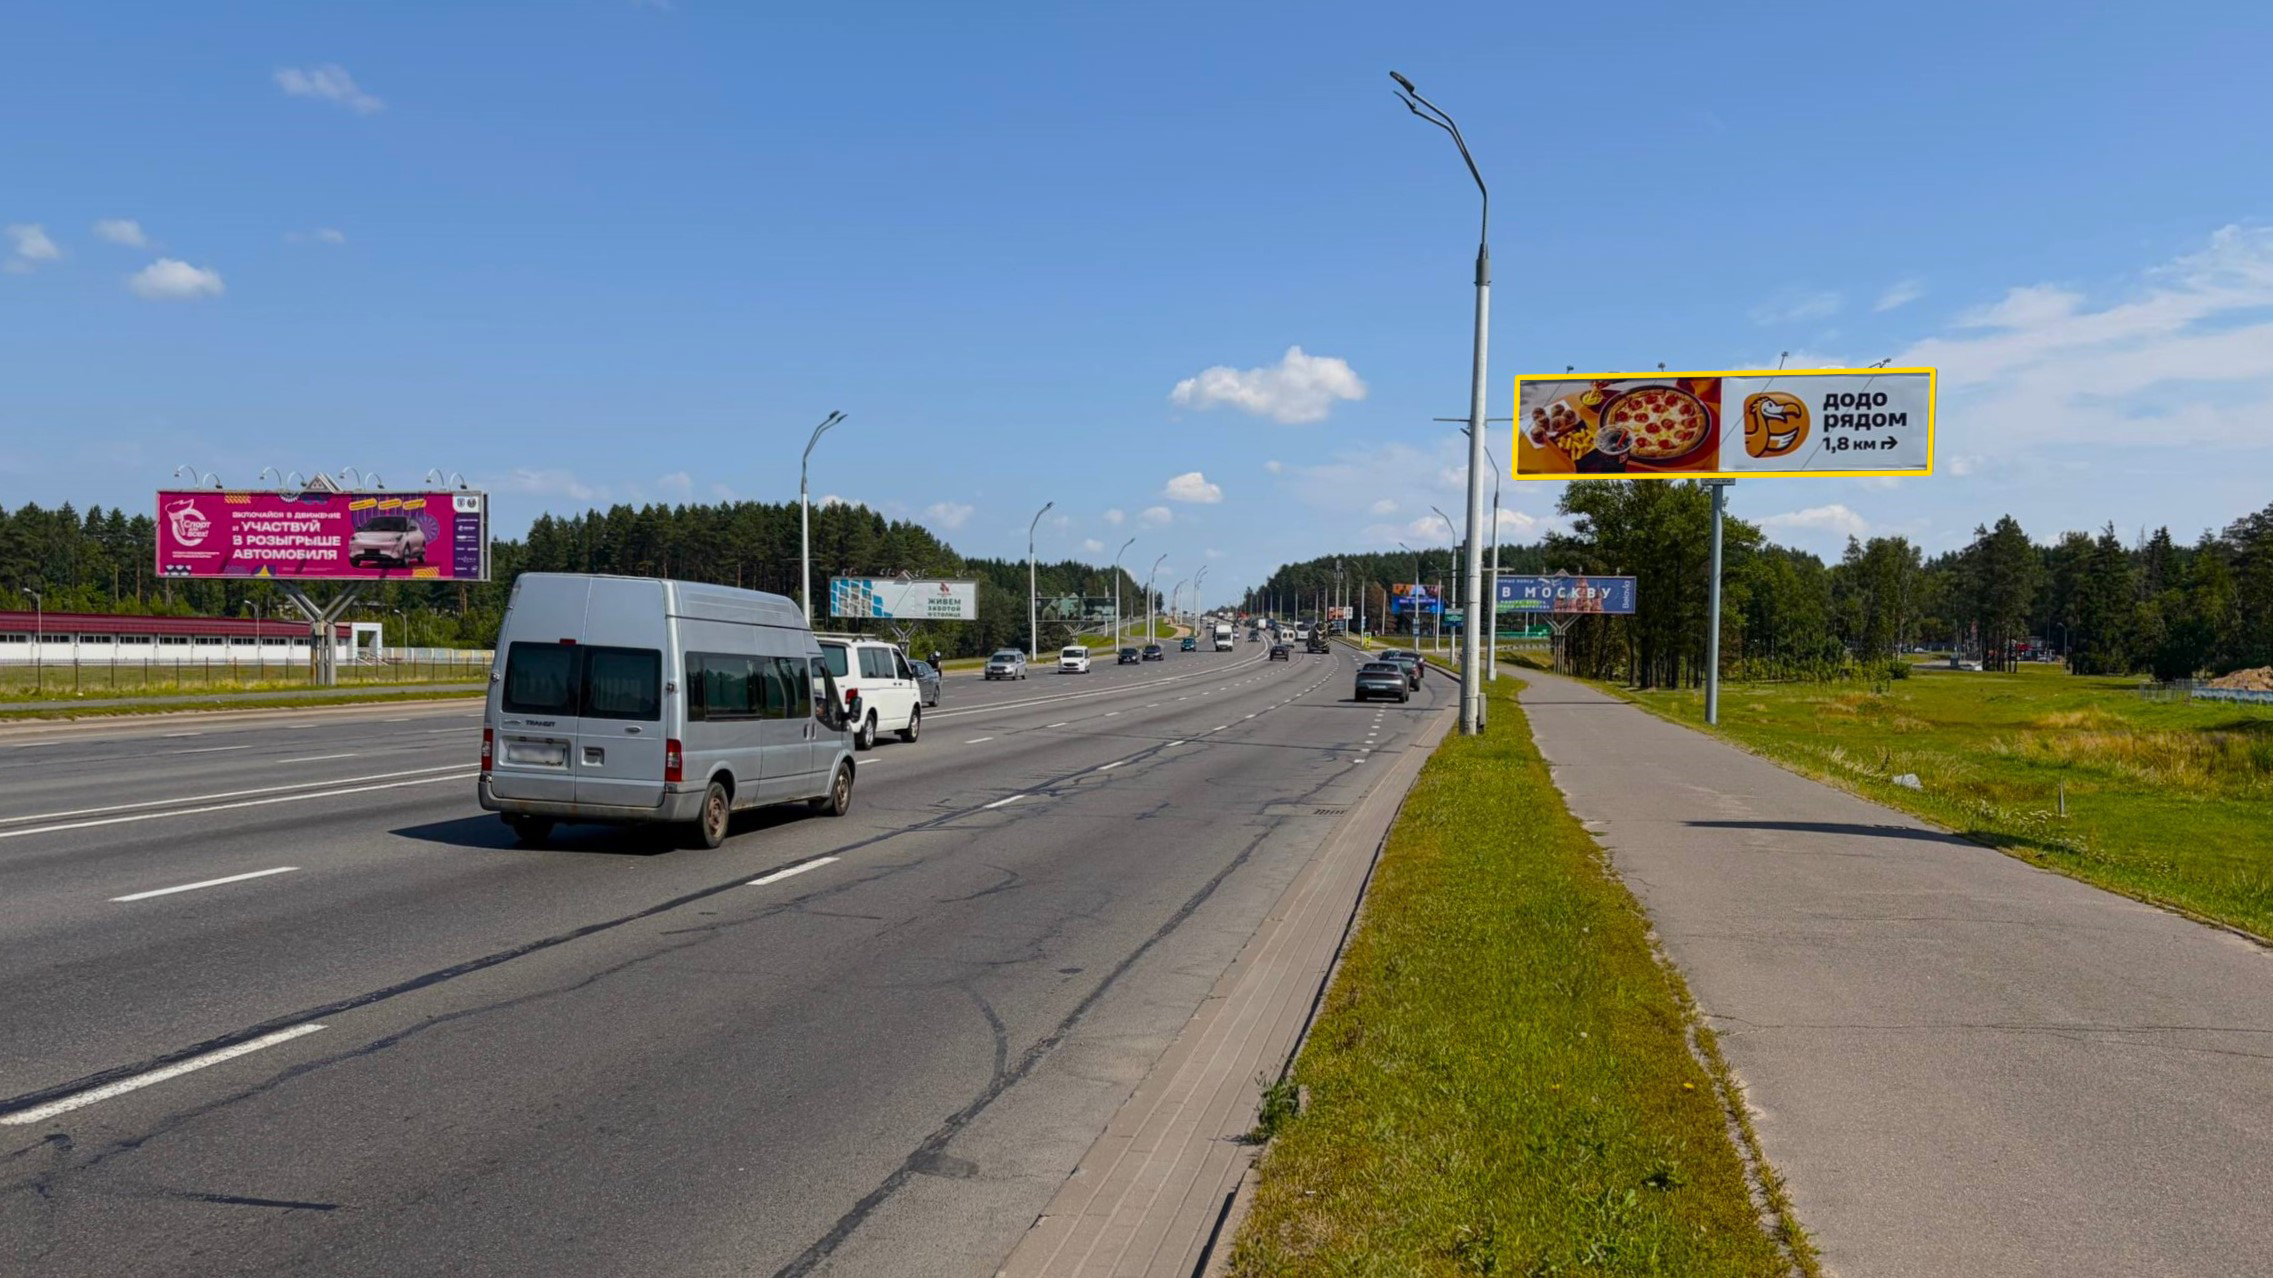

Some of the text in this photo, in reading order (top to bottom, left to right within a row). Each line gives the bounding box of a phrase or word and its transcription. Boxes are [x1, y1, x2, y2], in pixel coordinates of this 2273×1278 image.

[1823, 392, 1888, 411] додо
[1823, 412, 1907, 433] рядом
[1822, 436, 1876, 454] 1,8 км
[294, 511, 341, 519] ДВИЖЕНИЕ
[183, 519, 212, 530] Спорт
[241, 519, 321, 532] УЧАСТВУЙ
[233, 535, 342, 546] В РОЗЫГРЫШЕ
[232, 549, 338, 560] АВТОМОБИЛЯ
[1502, 586, 1611, 599] В МОСКВУ
